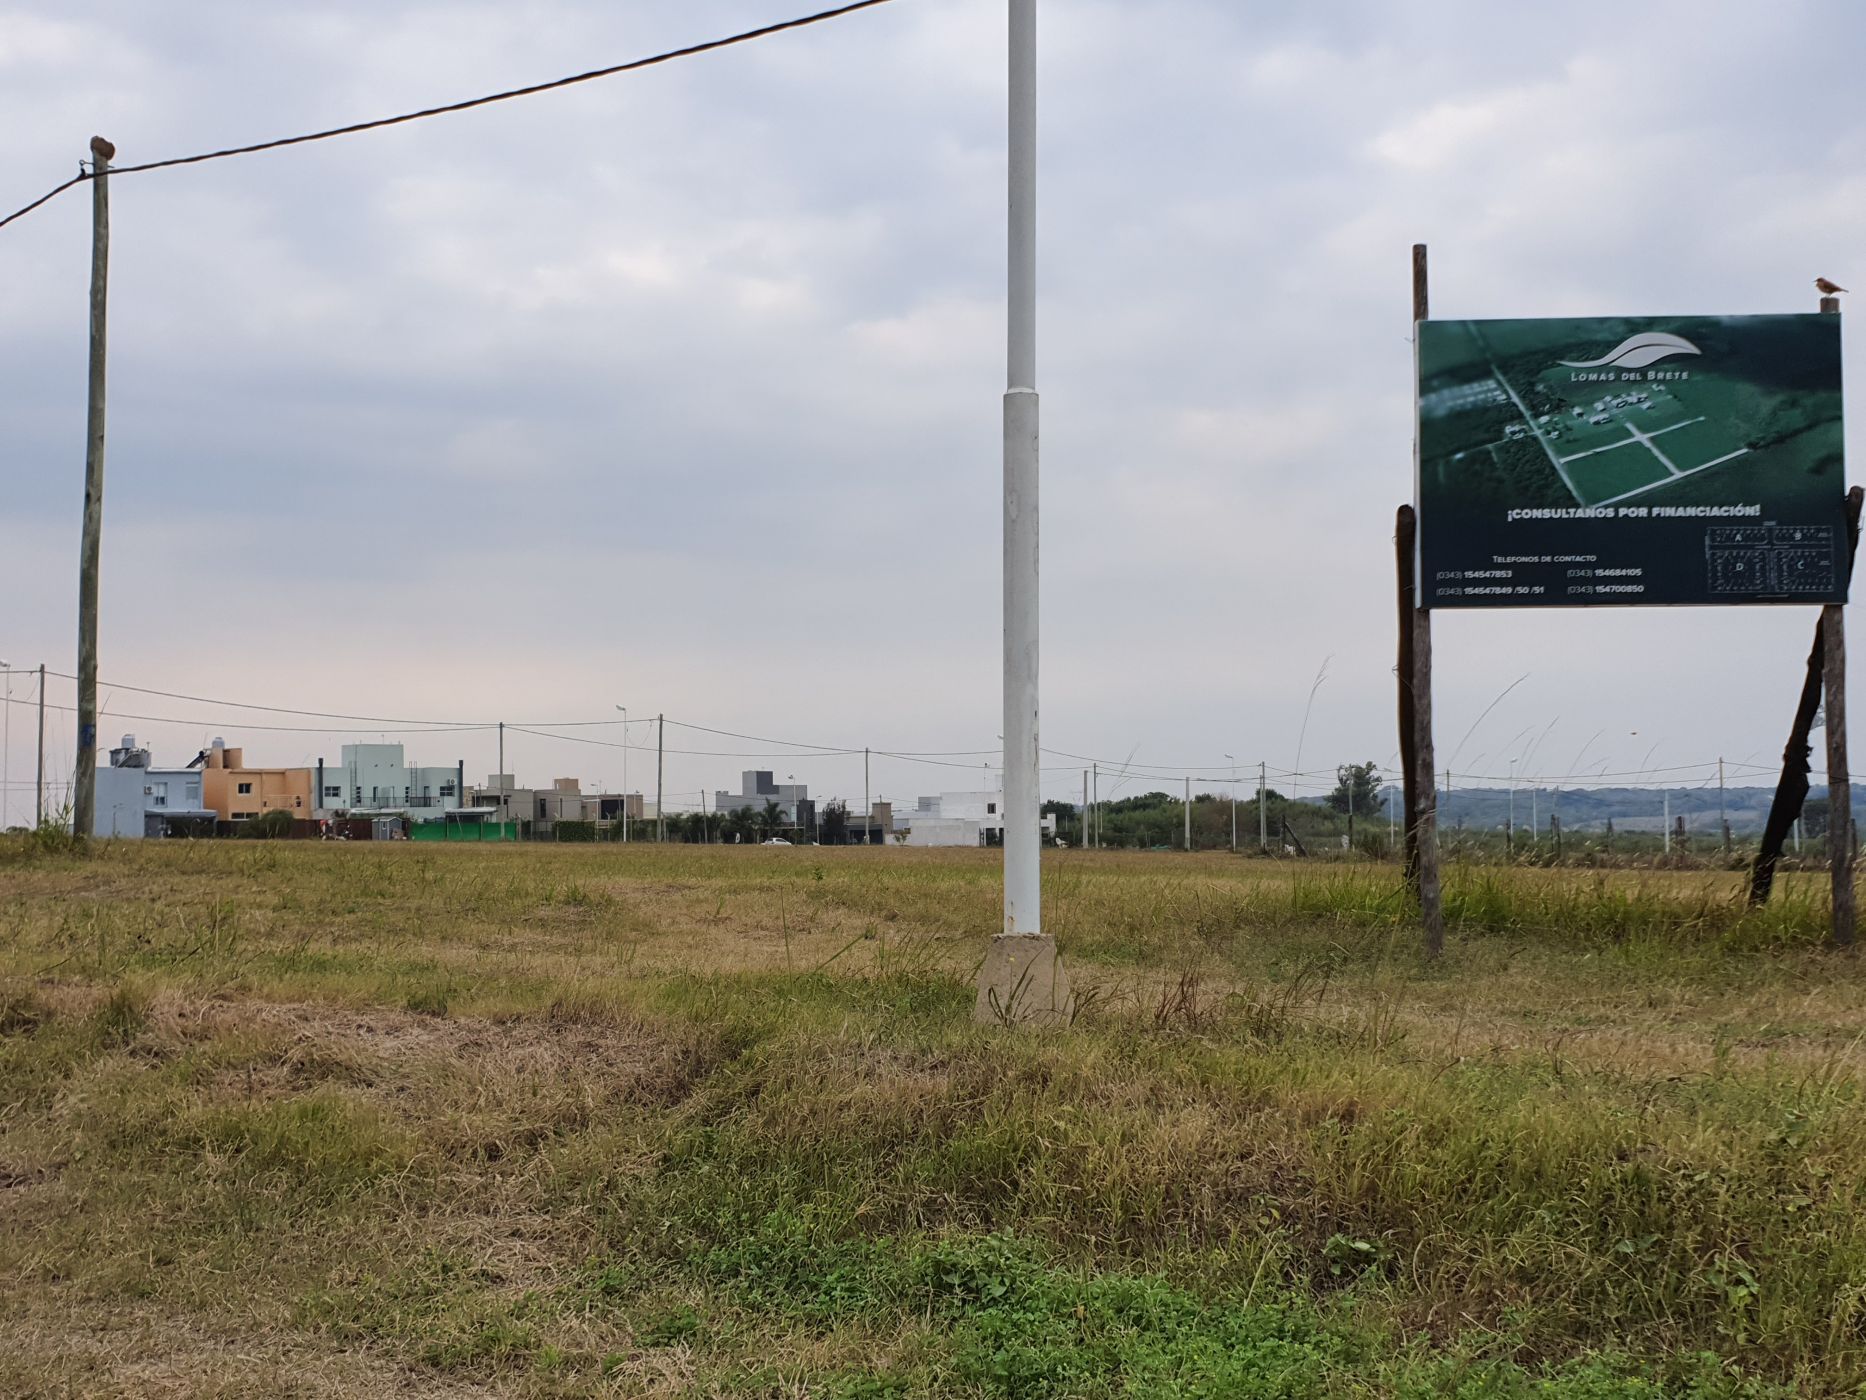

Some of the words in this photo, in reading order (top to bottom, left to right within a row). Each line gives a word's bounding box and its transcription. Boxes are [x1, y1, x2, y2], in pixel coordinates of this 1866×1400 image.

[1570, 371, 1616, 382] LOMAS
[1621, 372, 1643, 381] DEL
[1647, 370, 1689, 381] BRETE
[1507, 507, 1615, 522] ¡CONSULTANOS
[1618, 507, 1649, 518] POR
[1651, 503, 1761, 518] FINANCIACIÓN!
[1493, 555, 1540, 563] TELEFONOS
[1541, 555, 1552, 563] DE
[1553, 555, 1597, 563] CONTACTO
